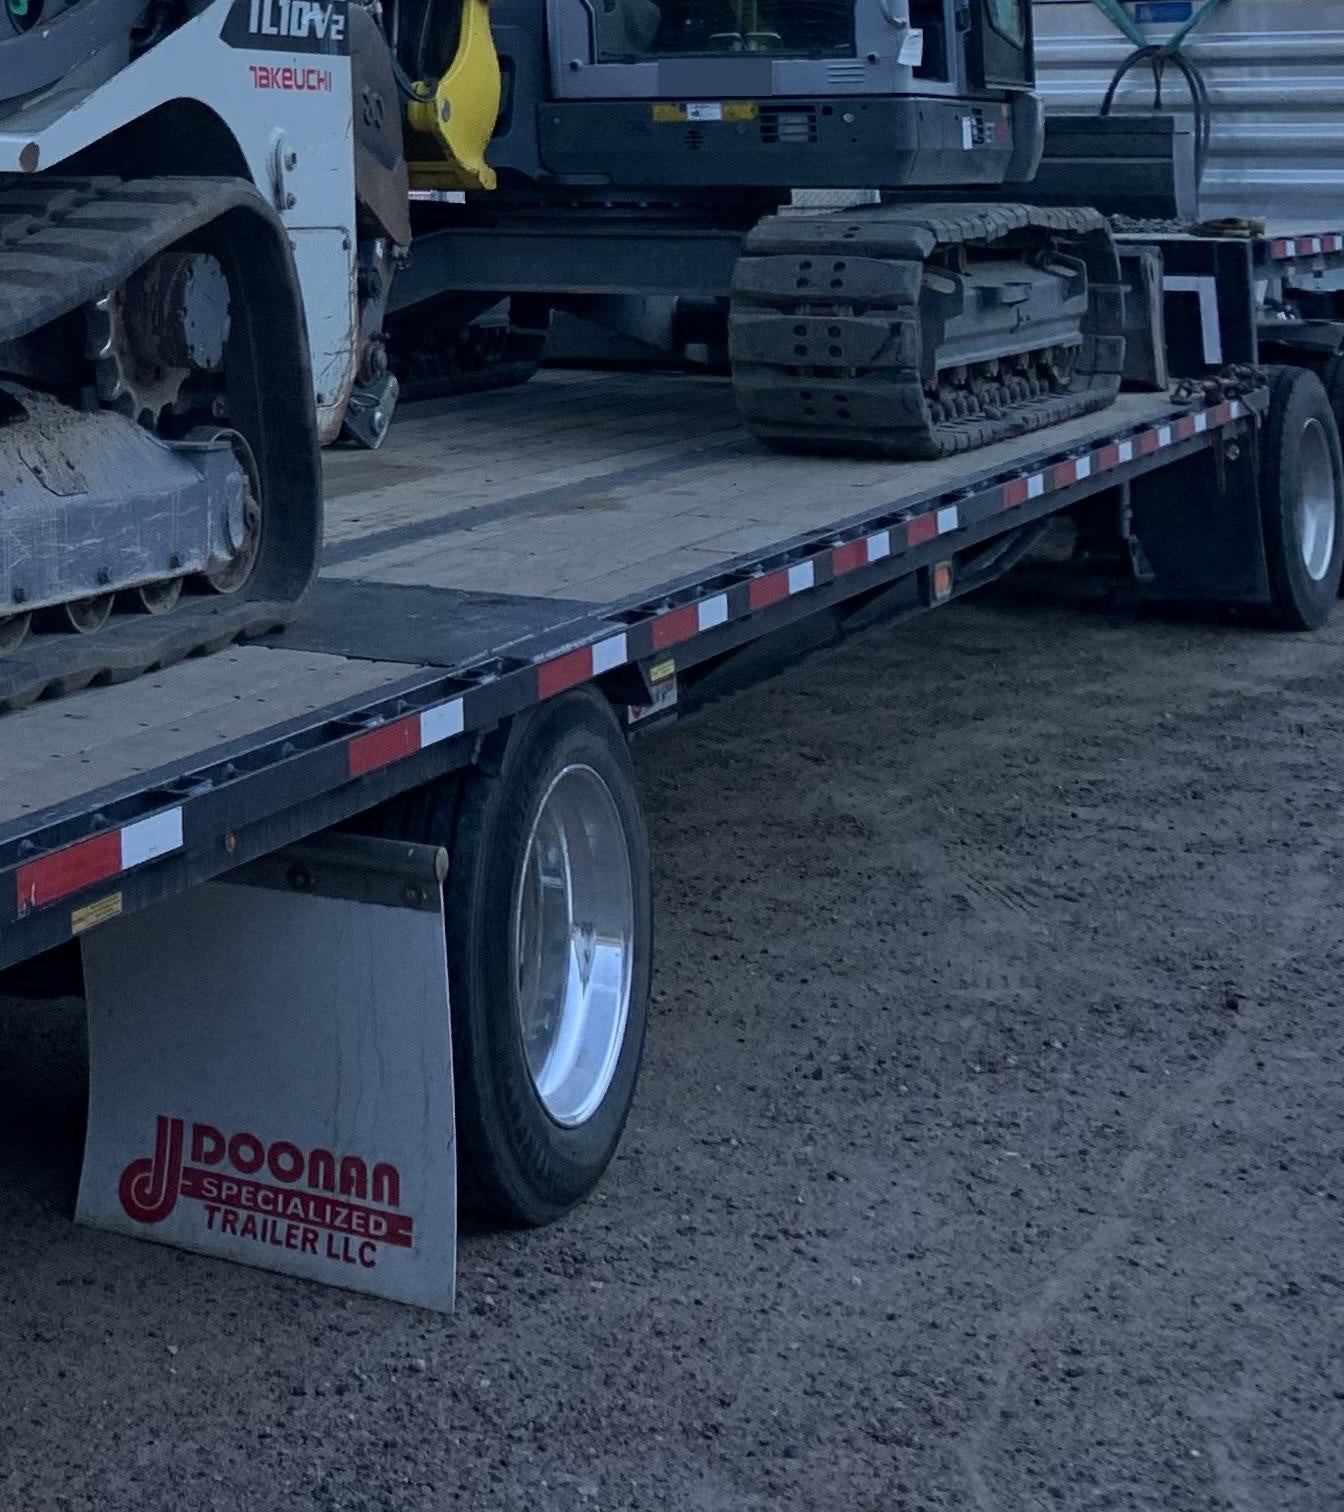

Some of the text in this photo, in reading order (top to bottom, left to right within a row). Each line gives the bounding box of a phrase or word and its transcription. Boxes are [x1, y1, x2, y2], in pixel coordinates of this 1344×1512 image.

[190, 1122, 400, 1208] DOONAN
[201, 1178, 389, 1237] SPECIALIZED
[204, 1203, 377, 1269] TRAILER LLC
